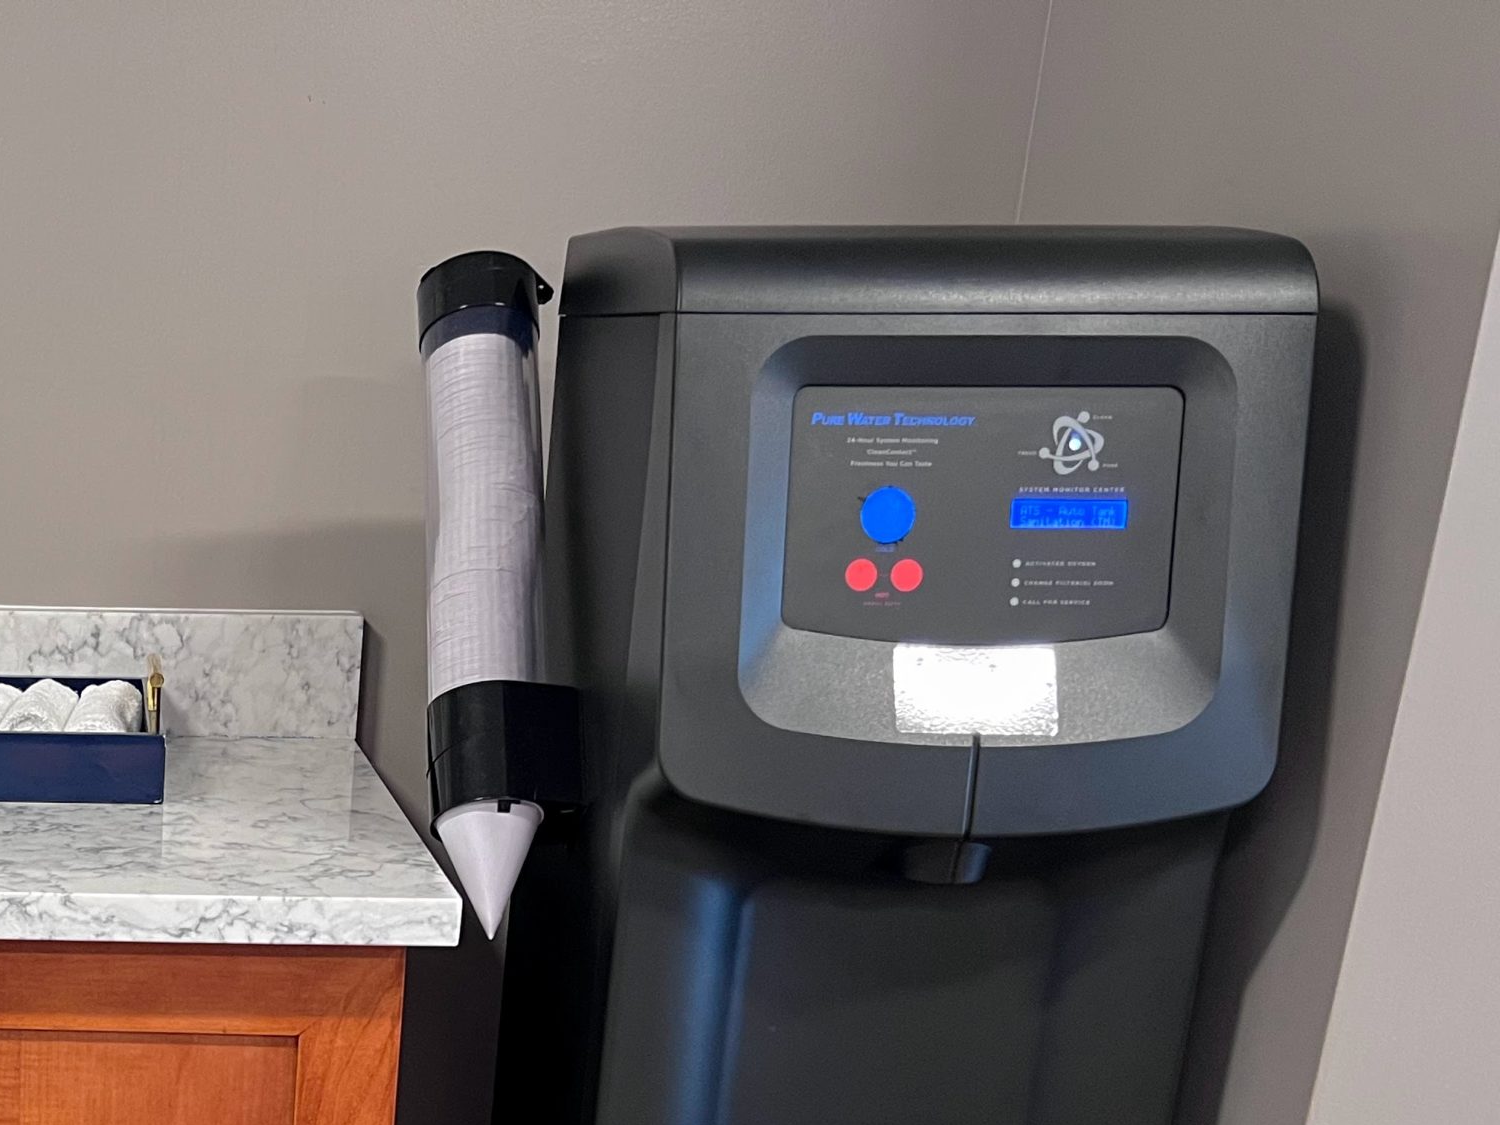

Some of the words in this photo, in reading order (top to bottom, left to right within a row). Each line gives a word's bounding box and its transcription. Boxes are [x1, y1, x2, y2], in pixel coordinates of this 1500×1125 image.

[810, 412, 845, 426] PURE
[848, 412, 891, 426] WATER
[893, 412, 976, 426] TECHNOLOGY
